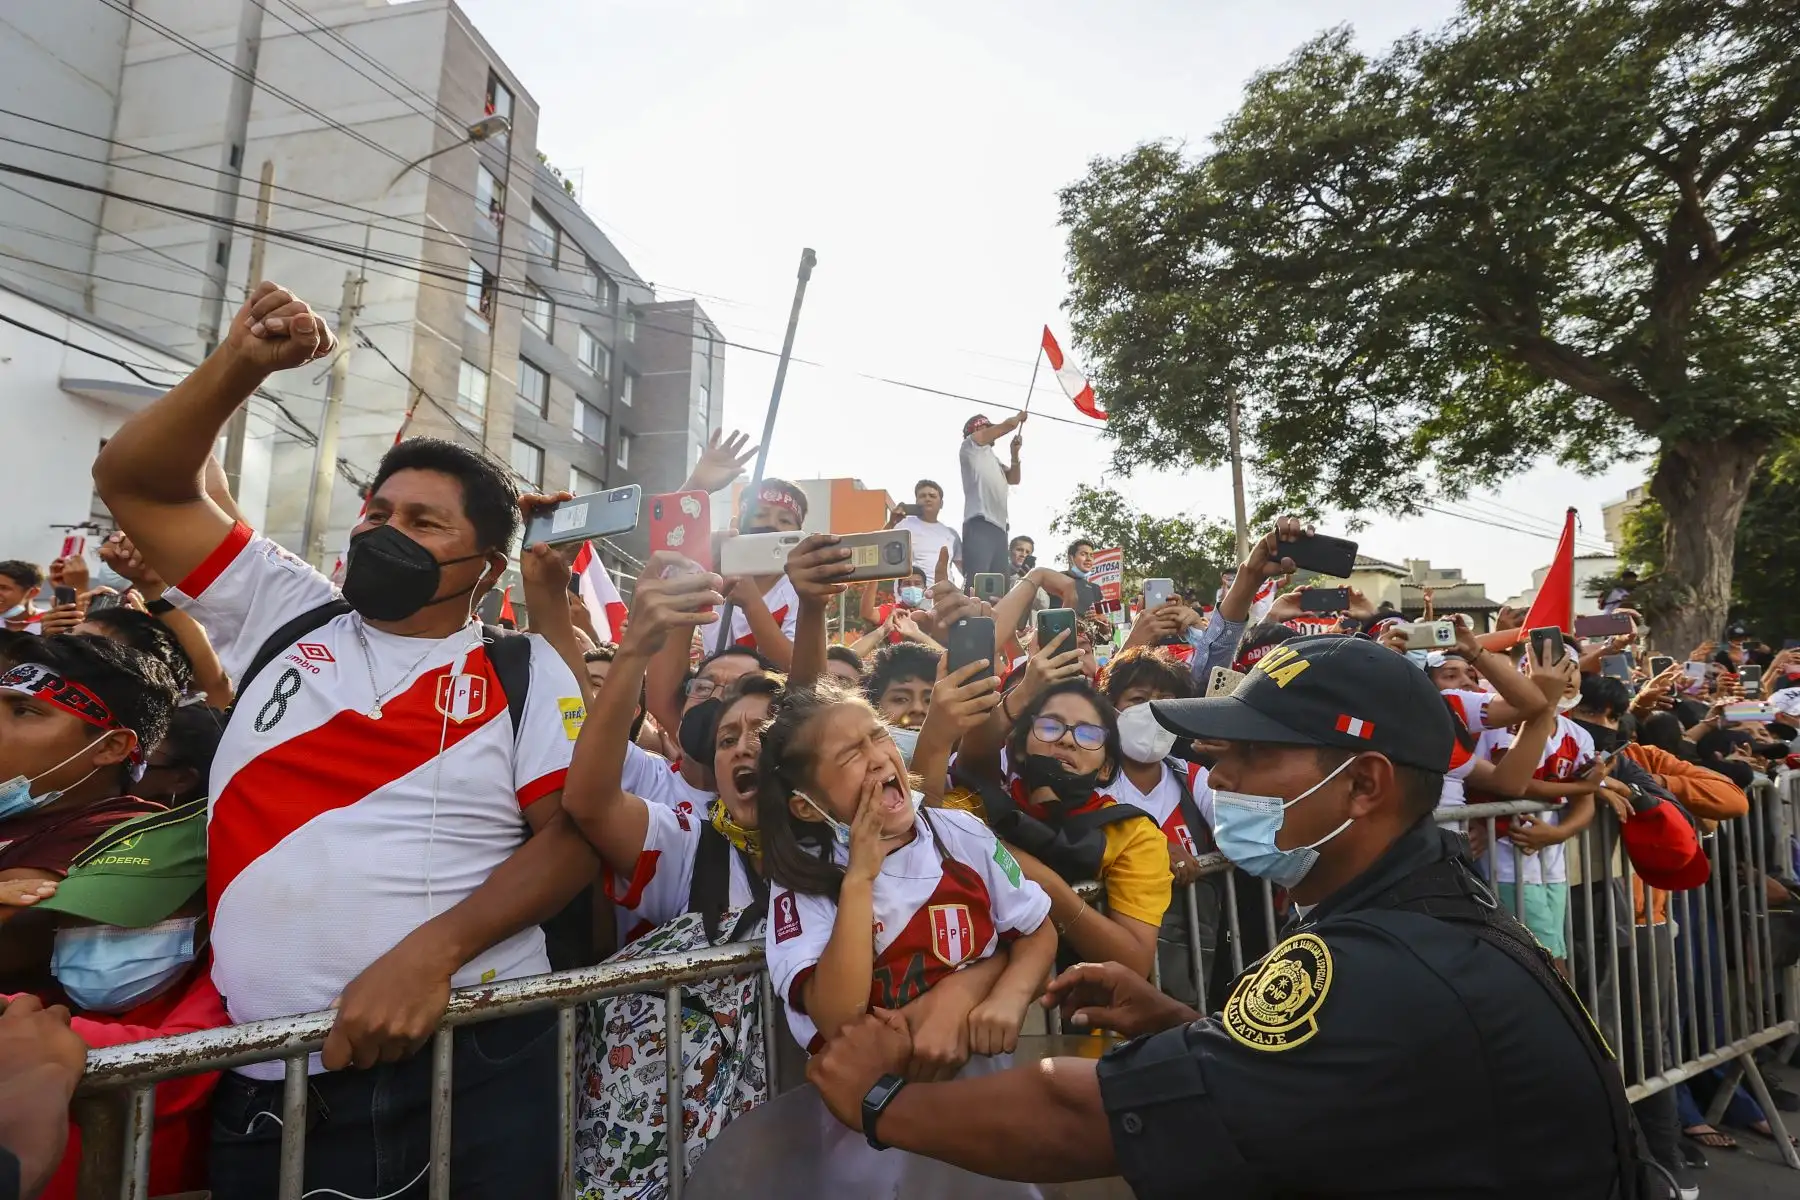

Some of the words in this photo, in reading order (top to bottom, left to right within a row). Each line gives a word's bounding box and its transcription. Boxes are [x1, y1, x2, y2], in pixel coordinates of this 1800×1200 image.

[285, 654, 321, 675] umbro
[26, 672, 110, 722] PER
[253, 667, 302, 733] 8
[563, 710, 582, 720] FIFA
[105, 856, 151, 866] DEERE
[1264, 983, 1288, 1001] PNP
[1228, 996, 1287, 1045] SALVATAJE
